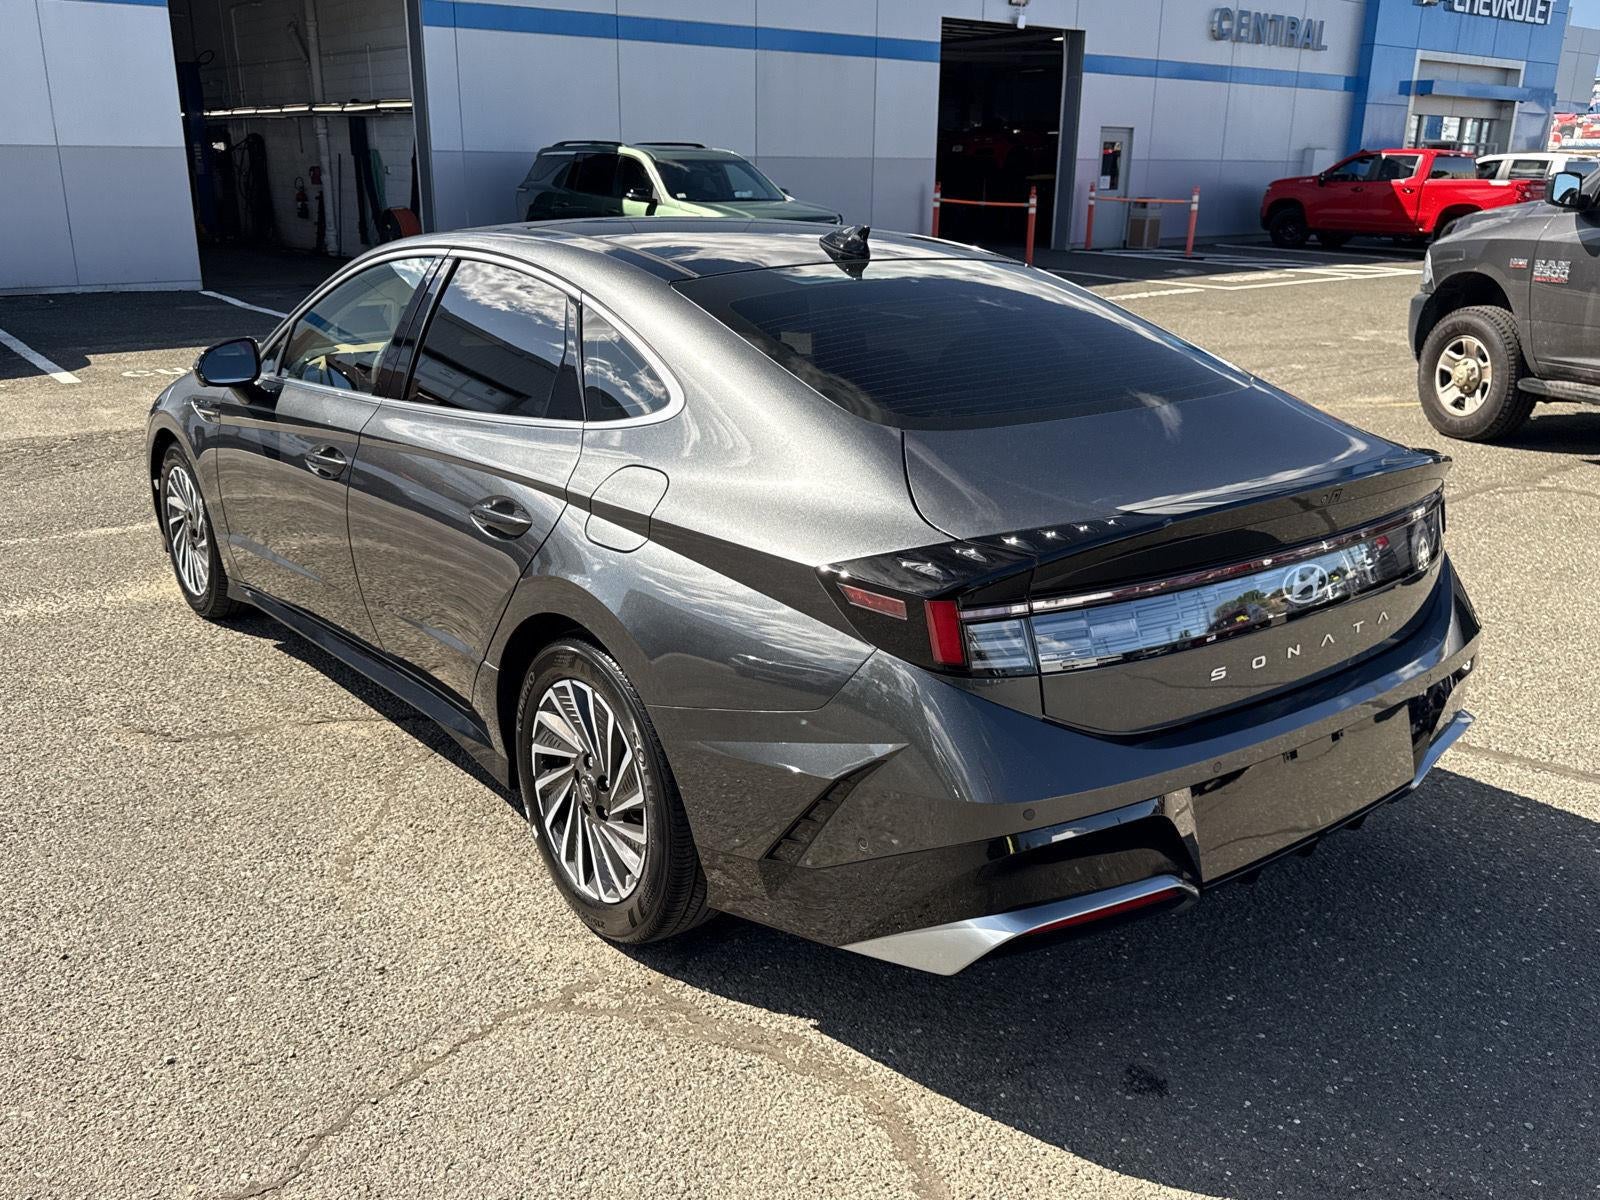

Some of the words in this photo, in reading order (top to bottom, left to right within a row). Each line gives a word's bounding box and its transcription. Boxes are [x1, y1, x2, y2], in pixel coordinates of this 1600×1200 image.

[1211, 7, 1327, 50] CENTRAL
[1453, 0, 1557, 25] CHEVROLET
[1210, 611, 1389, 682] SONATA
